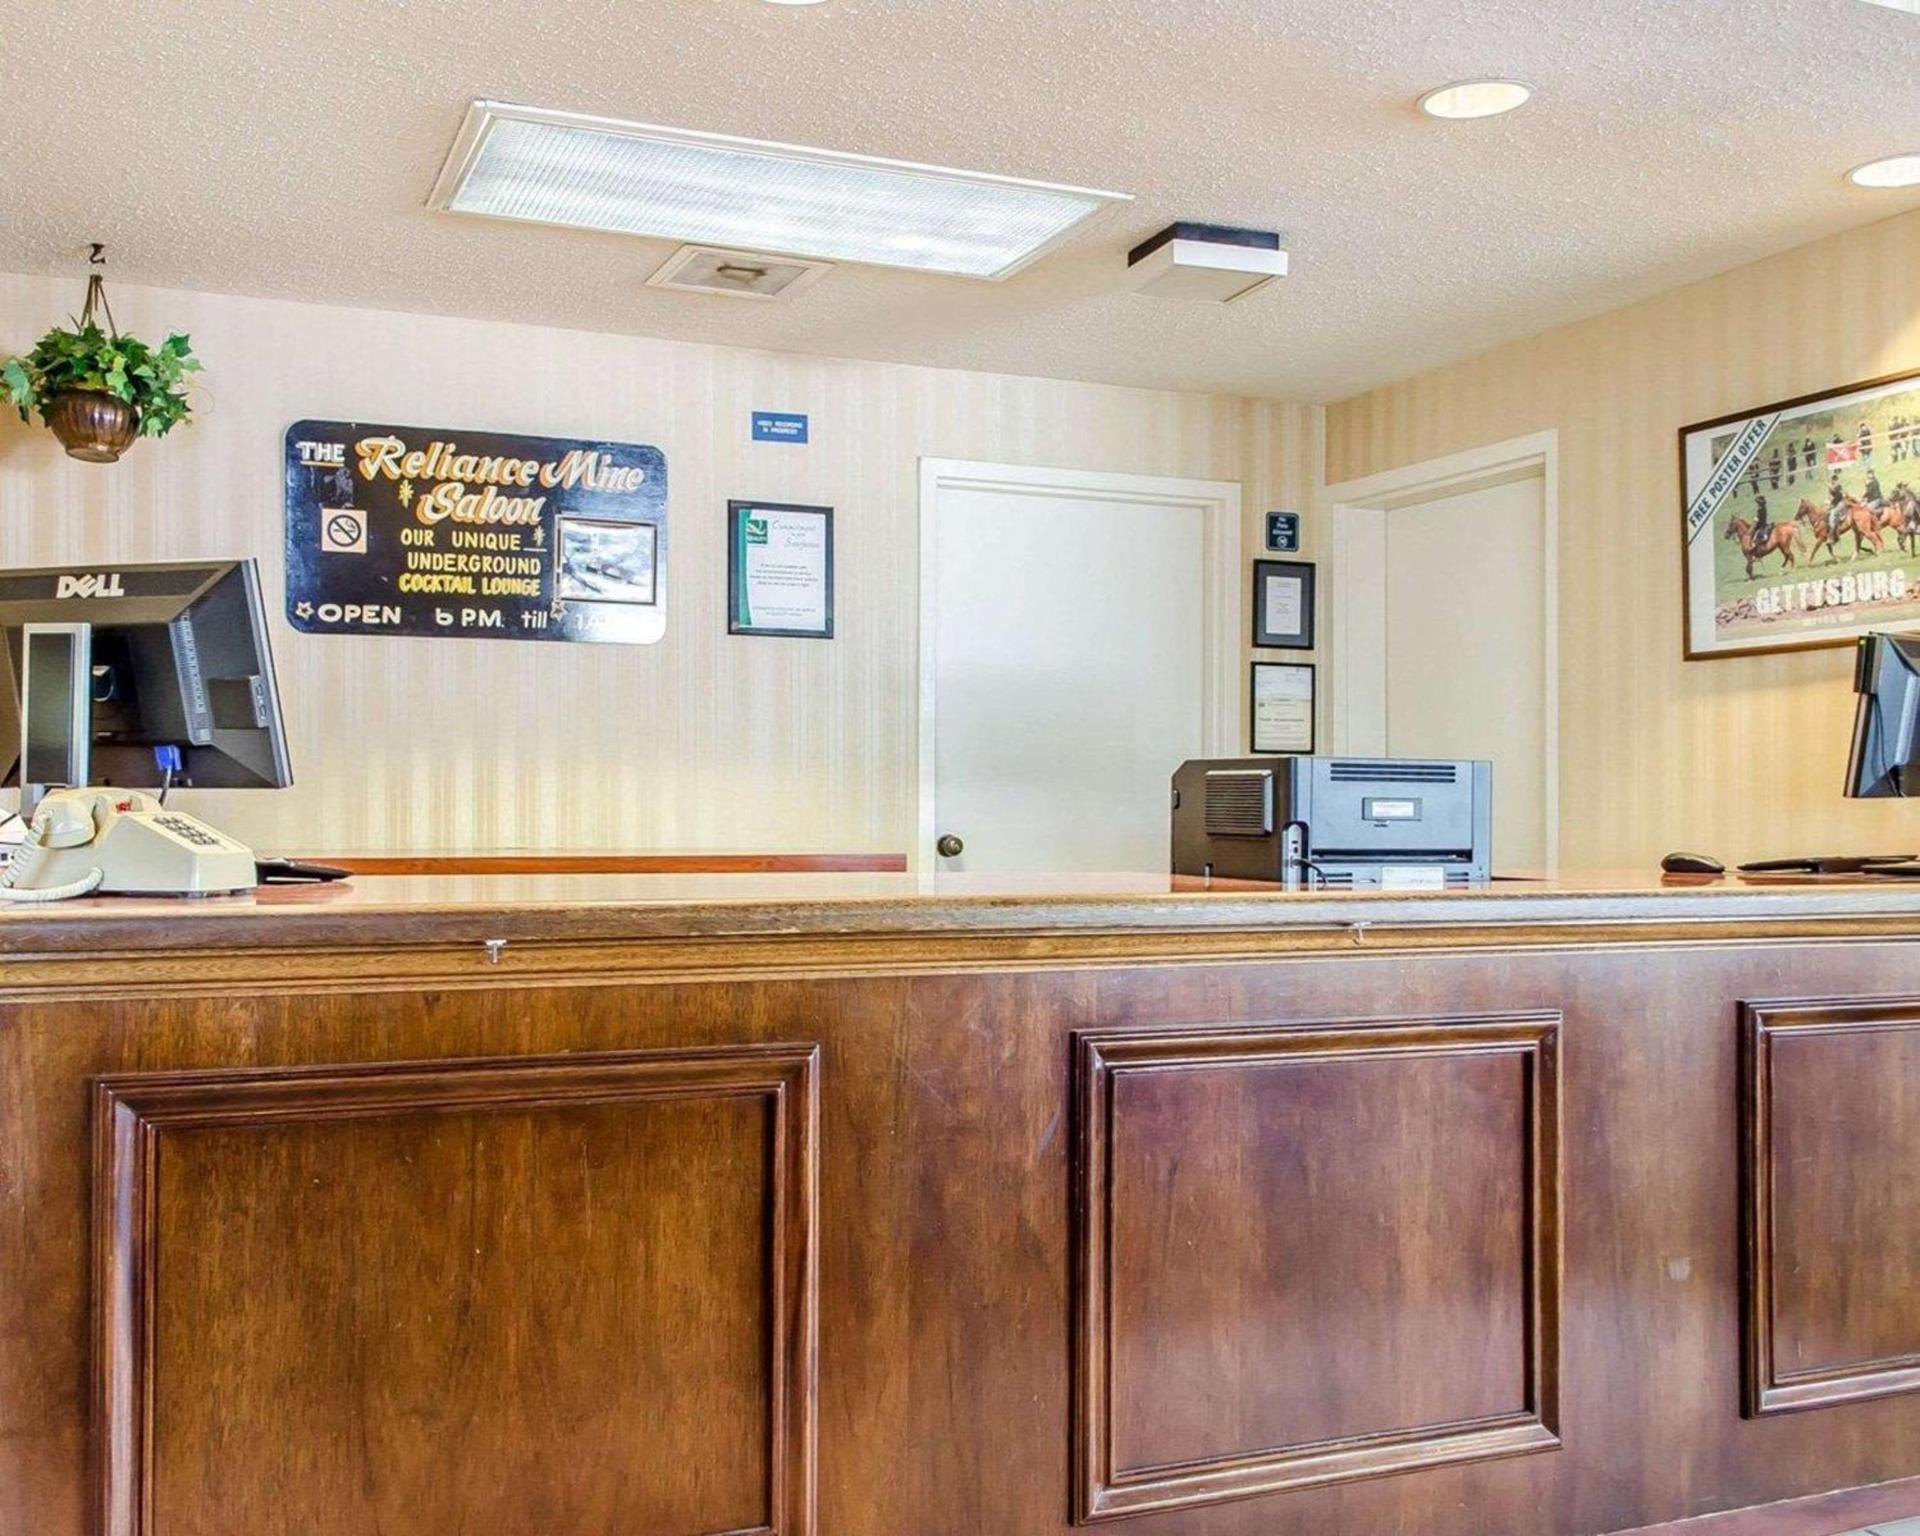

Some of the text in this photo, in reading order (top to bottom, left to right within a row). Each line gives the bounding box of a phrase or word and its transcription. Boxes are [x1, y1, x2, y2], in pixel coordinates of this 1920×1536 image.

[295, 434, 645, 493] THE Reliance Mine
[1689, 418, 1767, 528] FREE POSTER OFFER
[416, 482, 547, 526] Saloon
[400, 528, 521, 551] OUR UNIQUE
[407, 551, 542, 576] UNDERGROUND
[56, 573, 125, 599] DELL
[399, 572, 542, 597] COCKTAIL LOUNGE
[1755, 567, 1905, 615] GETTYSBURG
[317, 603, 402, 625] OPEN
[521, 610, 548, 629] till
